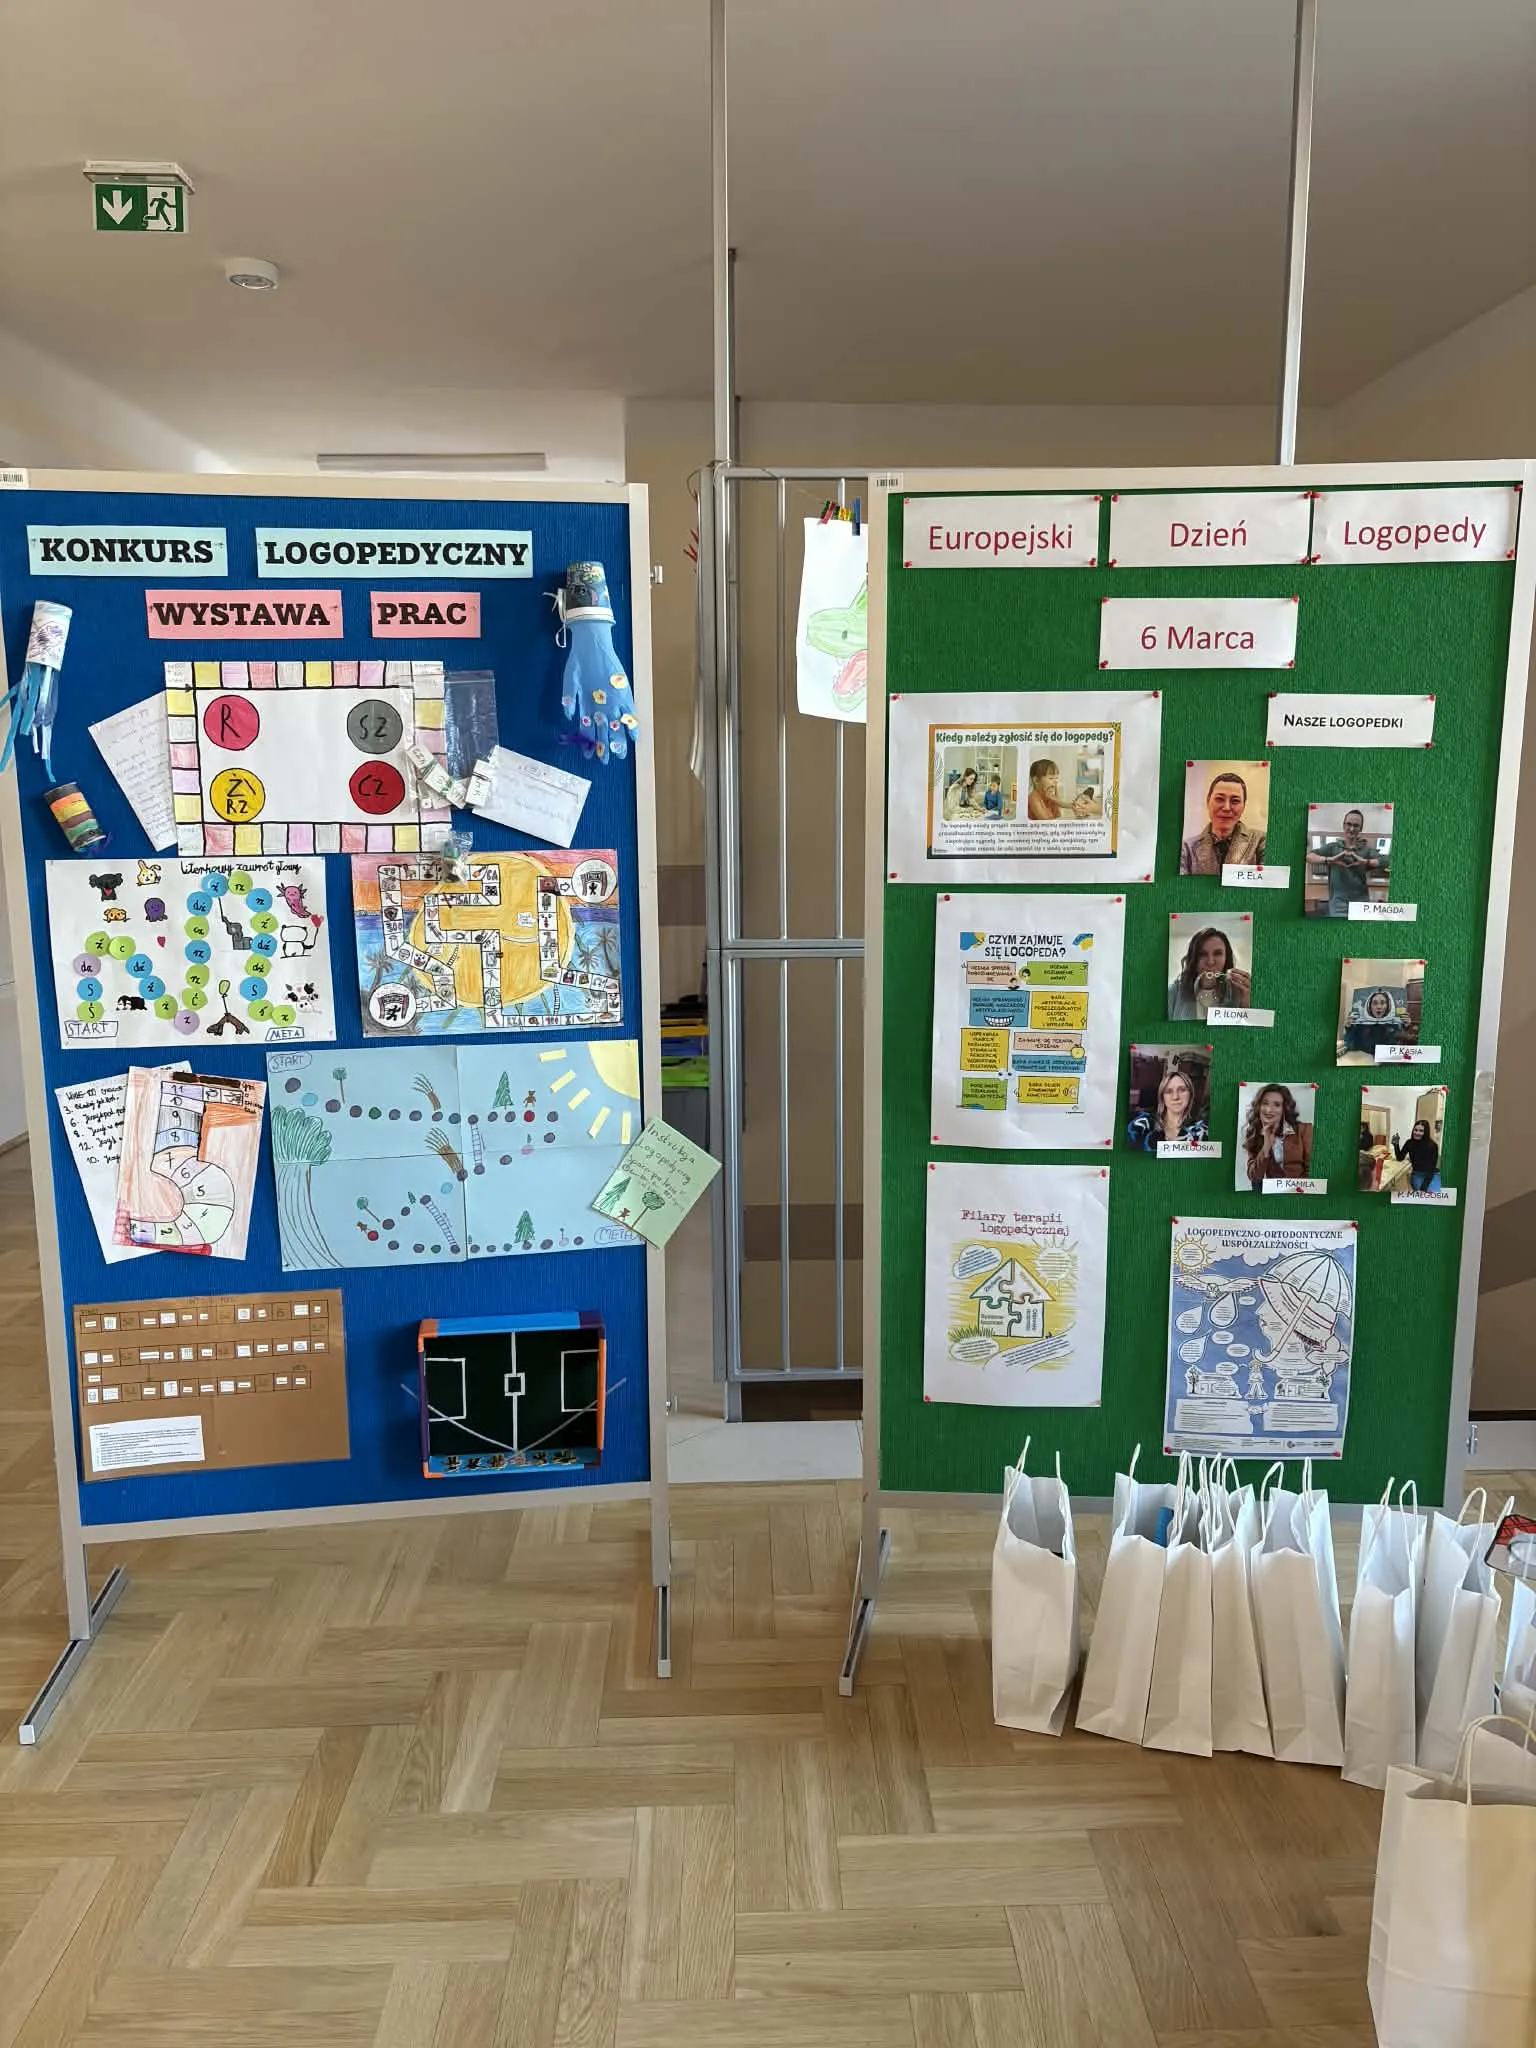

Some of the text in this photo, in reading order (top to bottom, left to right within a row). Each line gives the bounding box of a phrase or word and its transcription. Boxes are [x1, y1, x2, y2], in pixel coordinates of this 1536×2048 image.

[928, 517, 1487, 555] Europejski Dzień Logopedy
[39, 538, 529, 566] KONKURS LOGOPEDYCZNY
[152, 602, 467, 626] WYSTAWA PRAC
[1140, 626, 1254, 650] 6 Marca
[220, 703, 241, 742] R
[1329, 716, 1403, 729] LOGOPEDKI
[936, 731, 1114, 744] Kiedy należy zgłosić się do logopedy?
[358, 774, 388, 796] CZ
[226, 799, 248, 815] RZ
[1247, 872, 1263, 881] ELA
[1373, 904, 1404, 914] MAGDA
[988, 934, 1064, 947] CZYM ZAJMUJE
[984, 946, 1067, 959] SIĘ LOGOPEDA?
[1223, 1009, 1249, 1019] ILONA
[68, 1022, 109, 1037] START
[270, 1029, 300, 1040] META
[271, 1055, 305, 1070] START
[195, 1184, 205, 1198] 5
[961, 1209, 1065, 1226] Filary terapii
[980, 1222, 1071, 1237] logopedycznej
[1187, 1226, 1343, 1240] LOGOPEDYCZNO-ORTODONTYCZNE
[1222, 1238, 1310, 1250] WSPÓŁZALEŻNOŚCI
